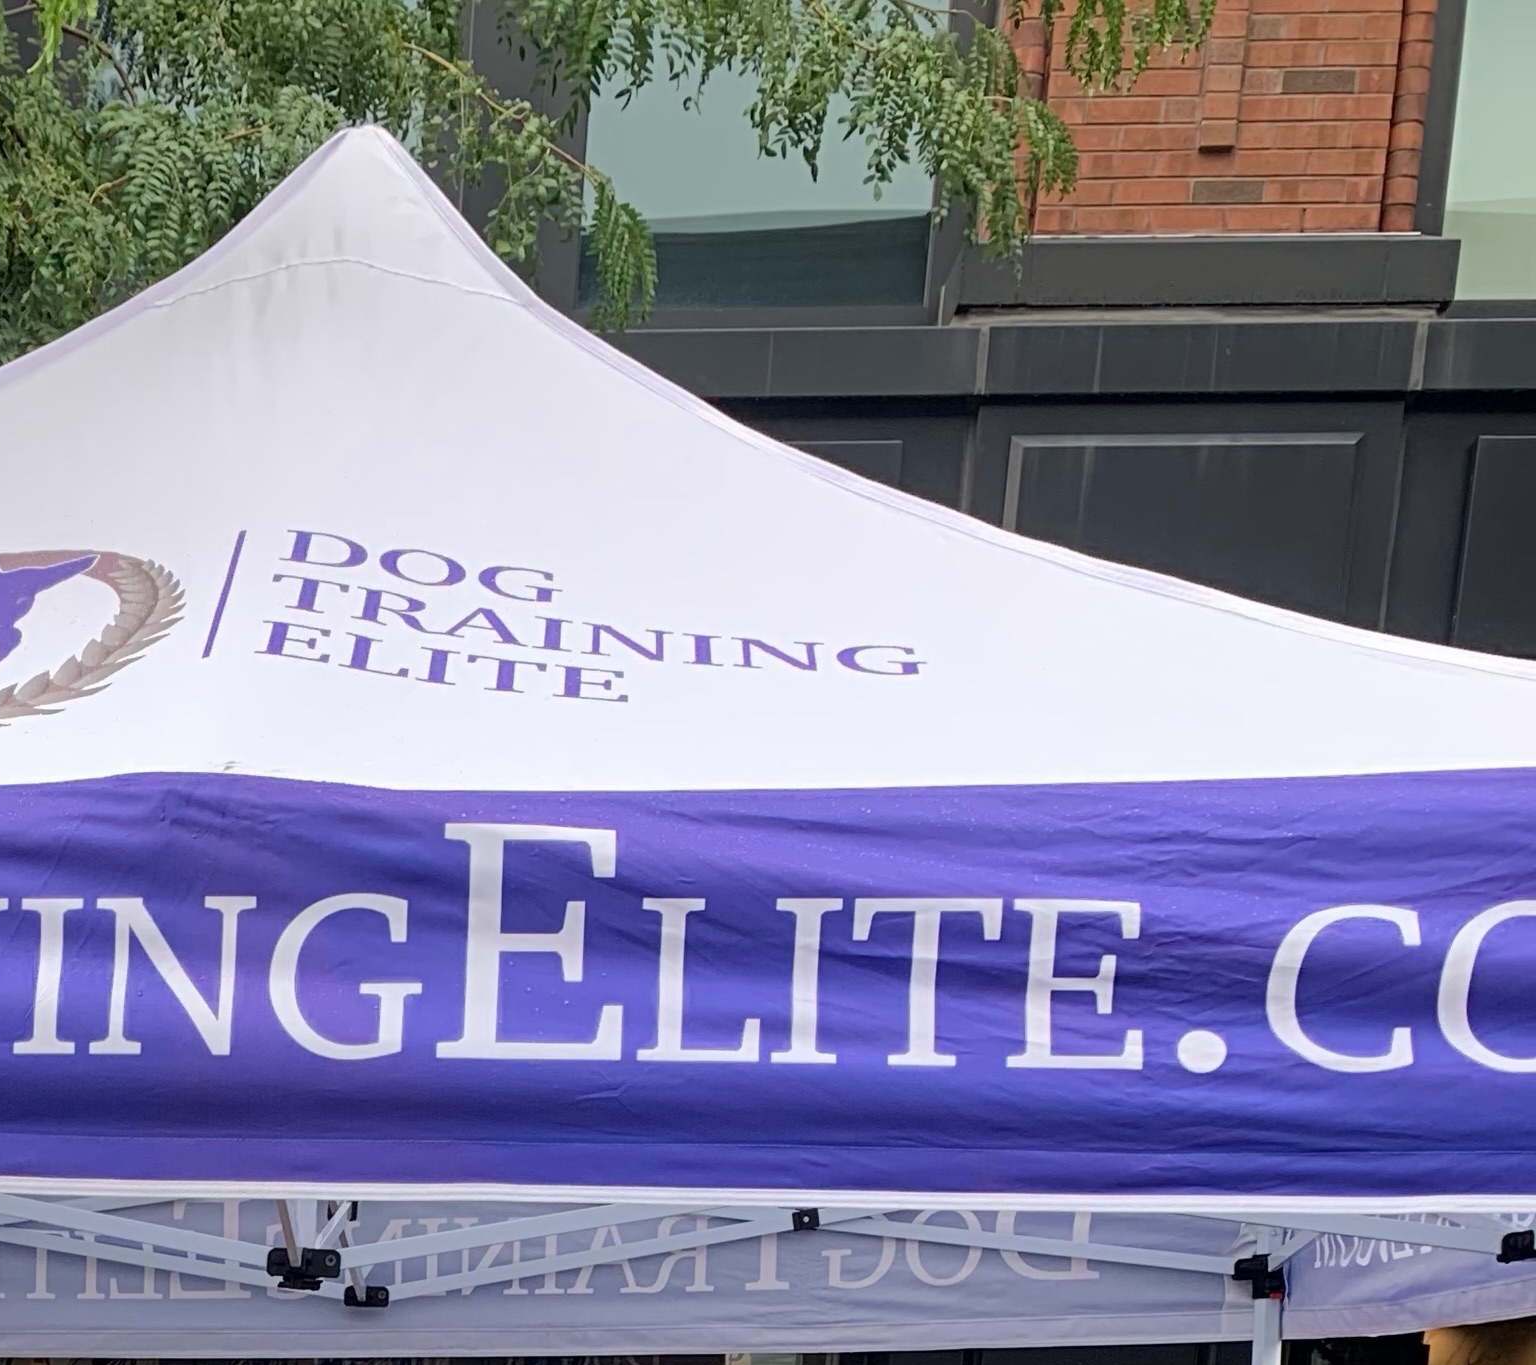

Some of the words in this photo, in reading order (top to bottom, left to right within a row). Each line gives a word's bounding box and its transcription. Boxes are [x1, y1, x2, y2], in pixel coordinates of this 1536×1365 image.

[279, 529, 563, 603] DOG
[254, 620, 629, 703] ELITE
[271, 573, 928, 676] TRAINING
